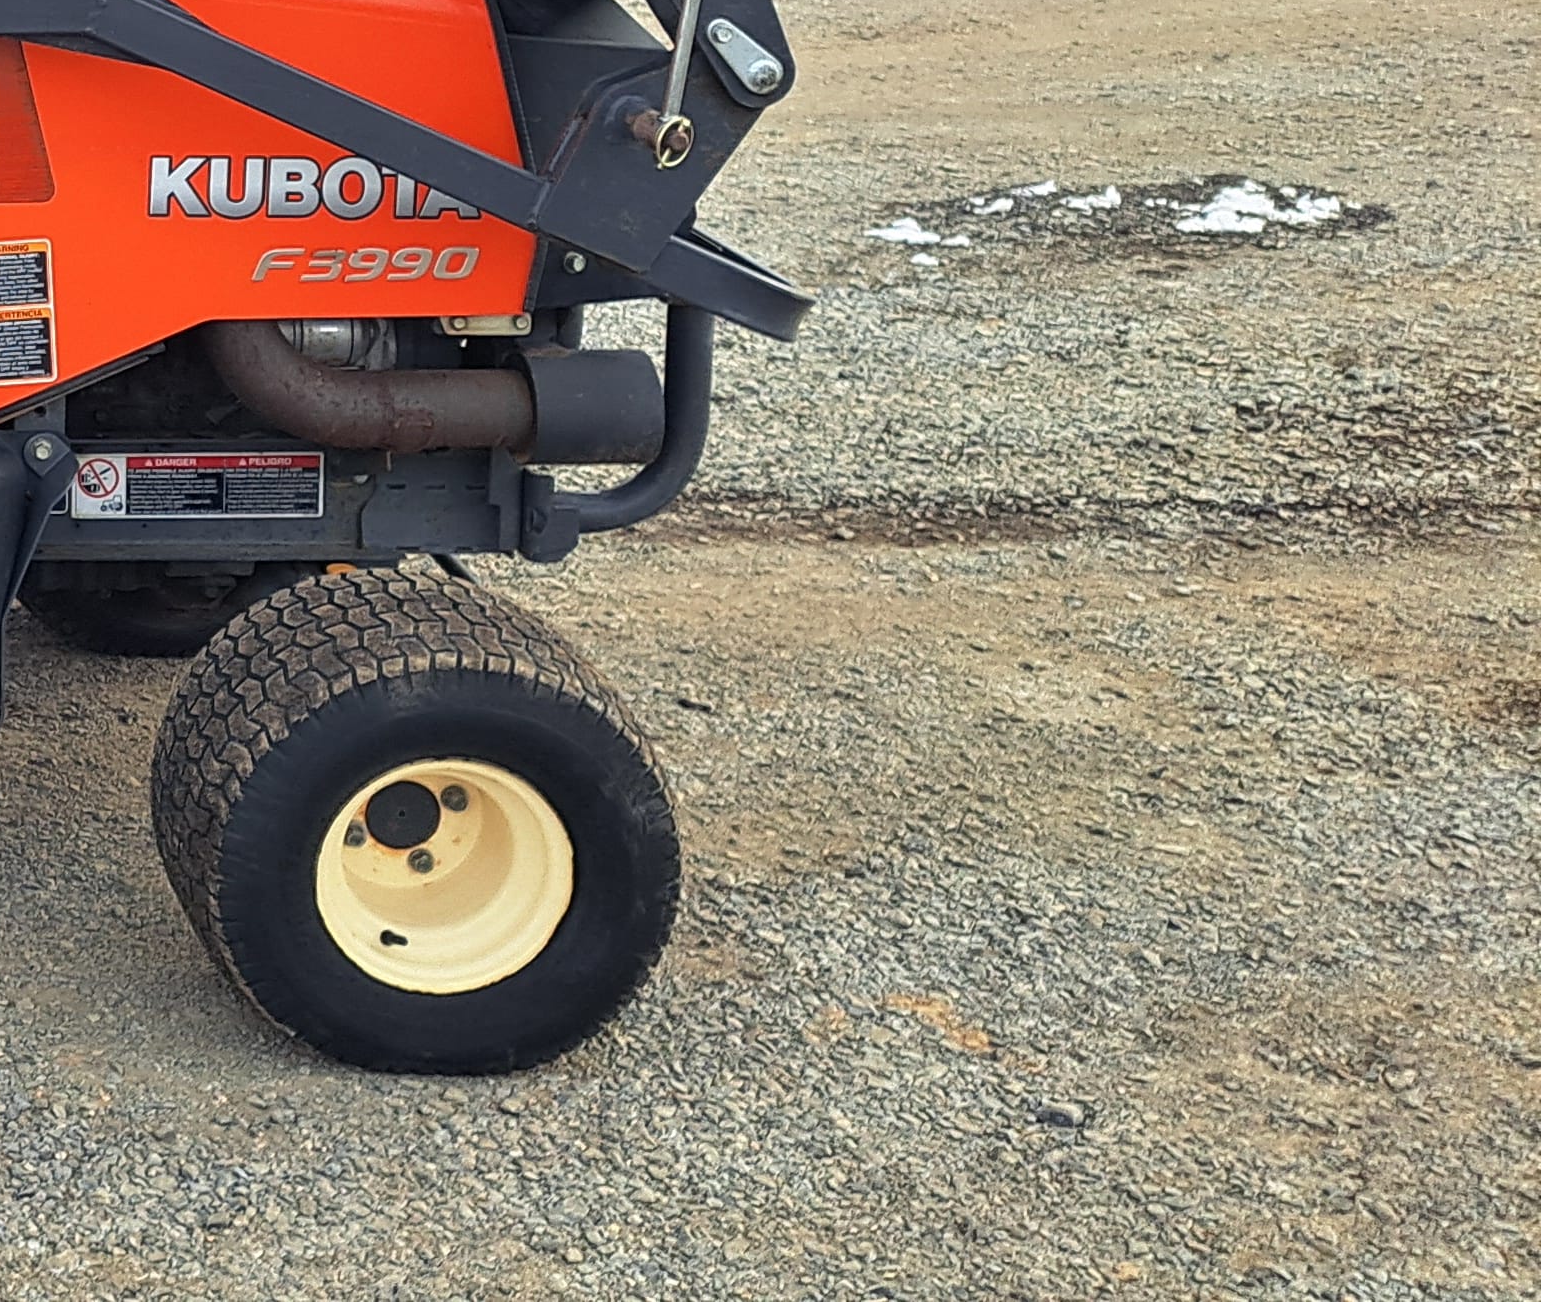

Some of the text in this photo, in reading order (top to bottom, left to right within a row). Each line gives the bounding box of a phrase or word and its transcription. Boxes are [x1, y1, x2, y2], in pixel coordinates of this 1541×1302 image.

[251, 246, 480, 282] F3990
[155, 458, 197, 467] DANGER
[248, 457, 292, 466] PELIGRO
